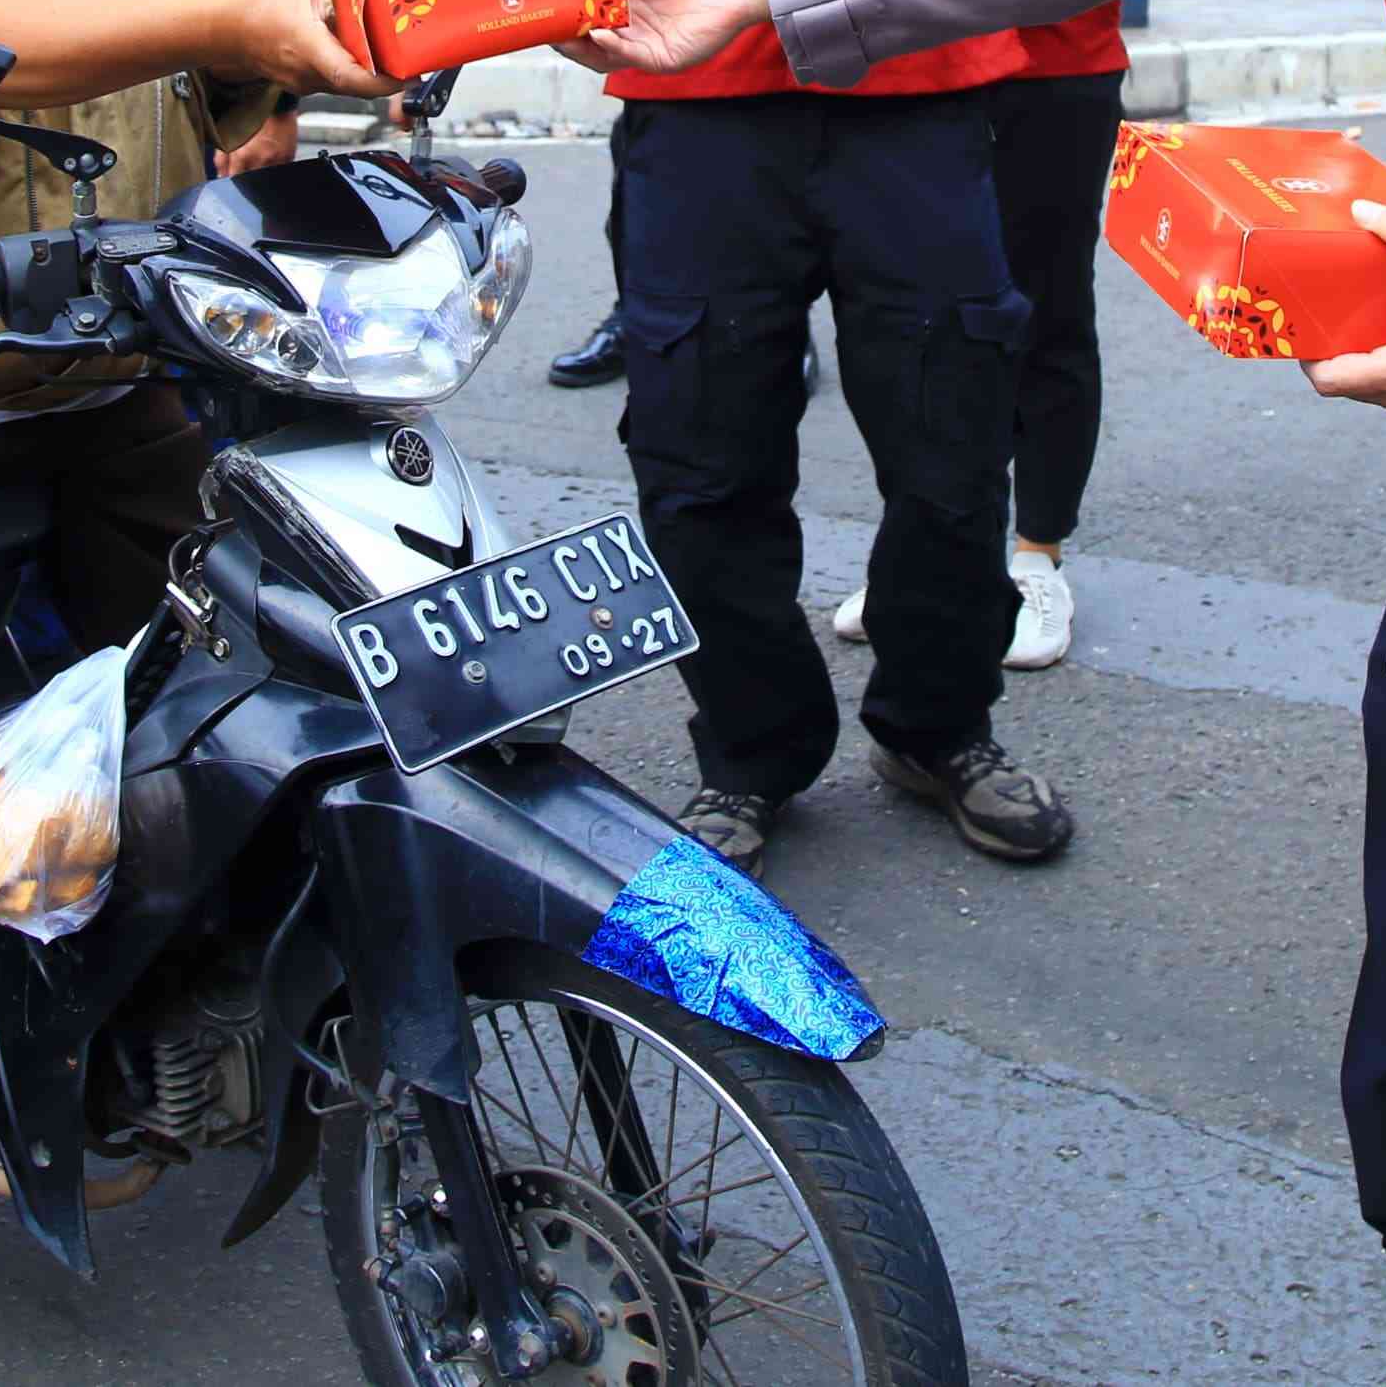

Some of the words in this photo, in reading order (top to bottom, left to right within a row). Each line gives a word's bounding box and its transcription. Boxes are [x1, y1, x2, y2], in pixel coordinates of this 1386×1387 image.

[349, 622, 400, 689] B
[412, 566, 550, 659] 6146
[551, 521, 655, 603] CIX
